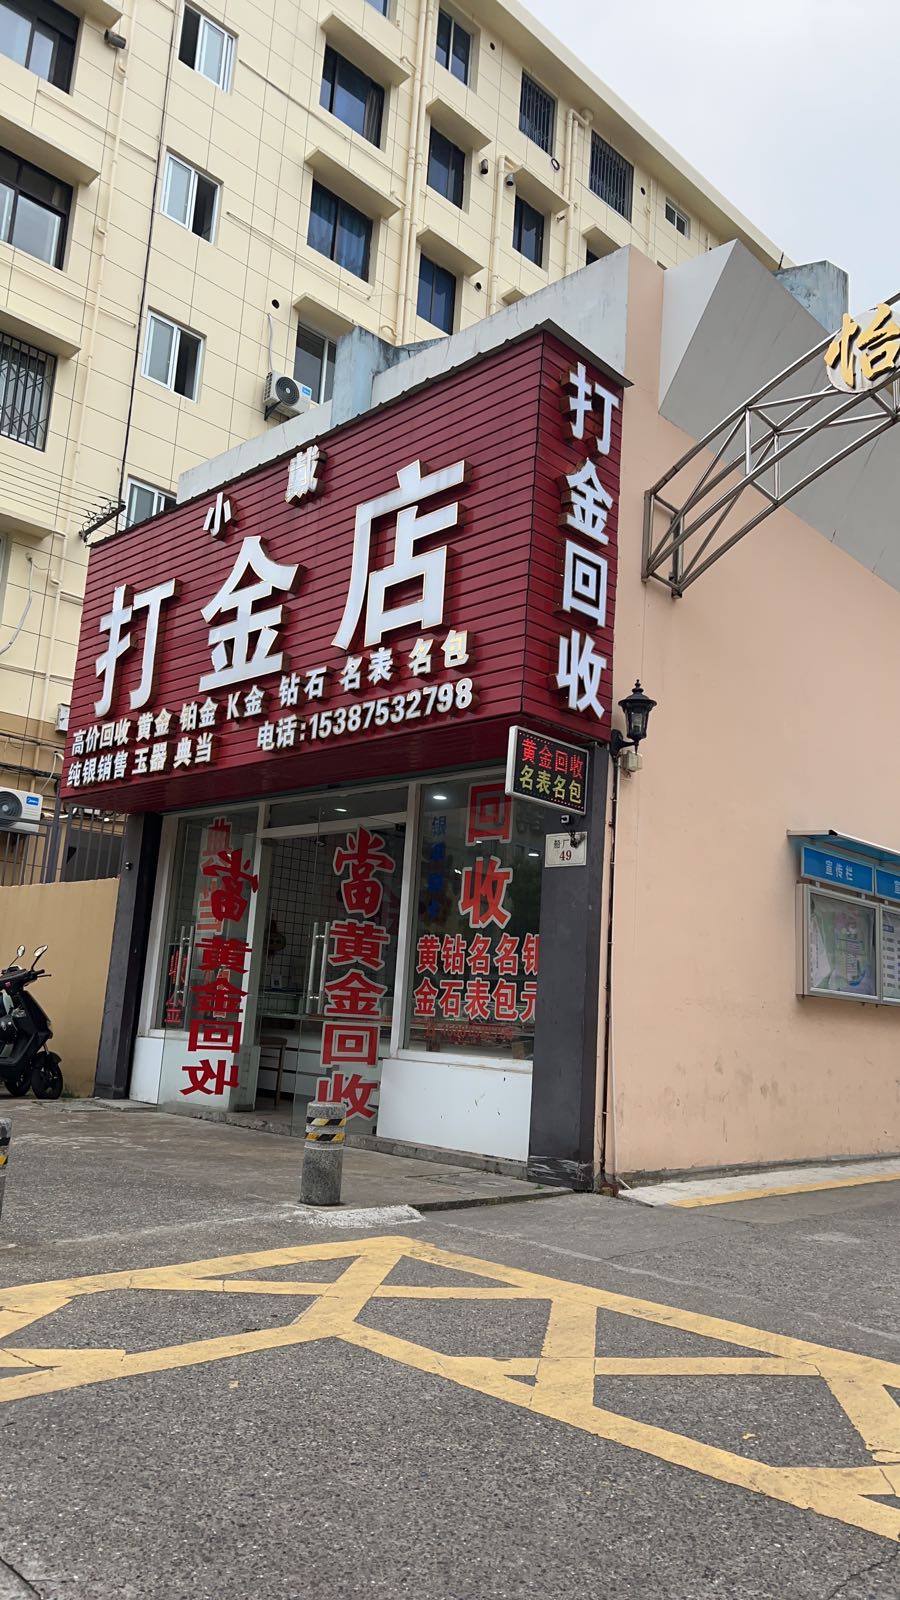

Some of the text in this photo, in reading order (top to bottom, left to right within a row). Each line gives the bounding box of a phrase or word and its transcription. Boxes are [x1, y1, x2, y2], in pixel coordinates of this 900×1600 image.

[555, 361, 619, 719] 打金回收
[93, 459, 465, 717] 打金店
[72, 629, 469, 756] 高价回收 黄金 铂金 K金 钻石 名表 名包
[66, 750, 129, 787] 纯银销售
[131, 741, 168, 775] 玉器
[174, 732, 213, 768] 典当
[519, 765, 582, 804] 名表名包
[521, 738, 584, 779] 黄金回收
[458, 783, 513, 928] 回收
[559, 849, 572, 861] 49
